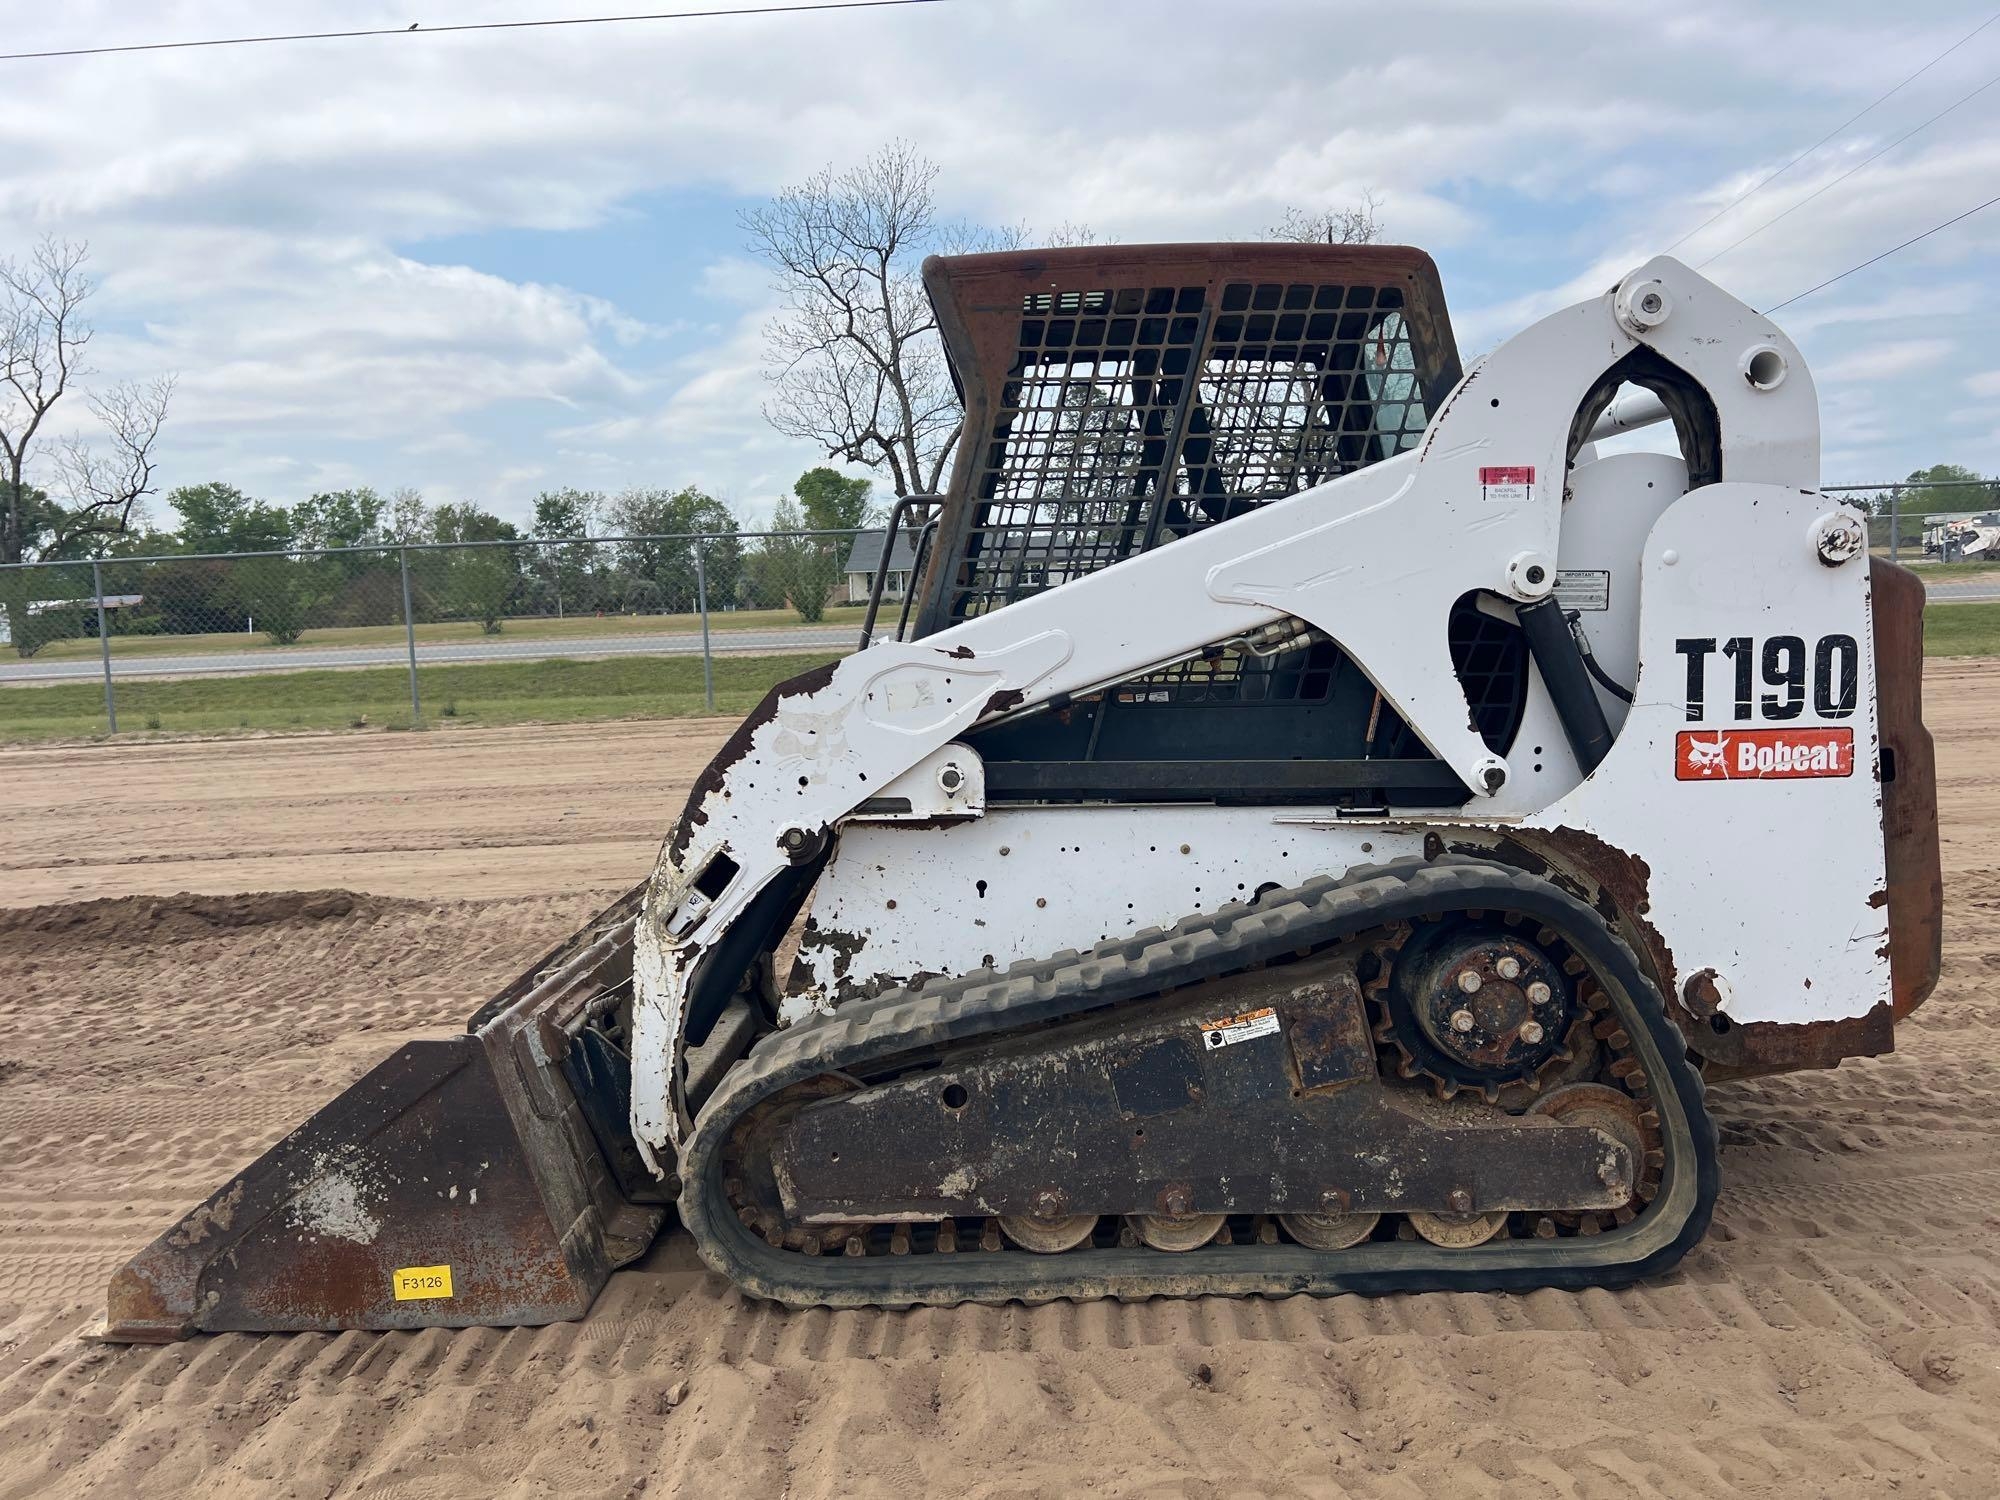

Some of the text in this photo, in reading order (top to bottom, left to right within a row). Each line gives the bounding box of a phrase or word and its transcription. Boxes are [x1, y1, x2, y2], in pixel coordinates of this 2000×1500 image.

[1676, 634, 1858, 721] T190
[1737, 740, 1839, 772] Bobcat
[402, 1276, 443, 1290] F3126
